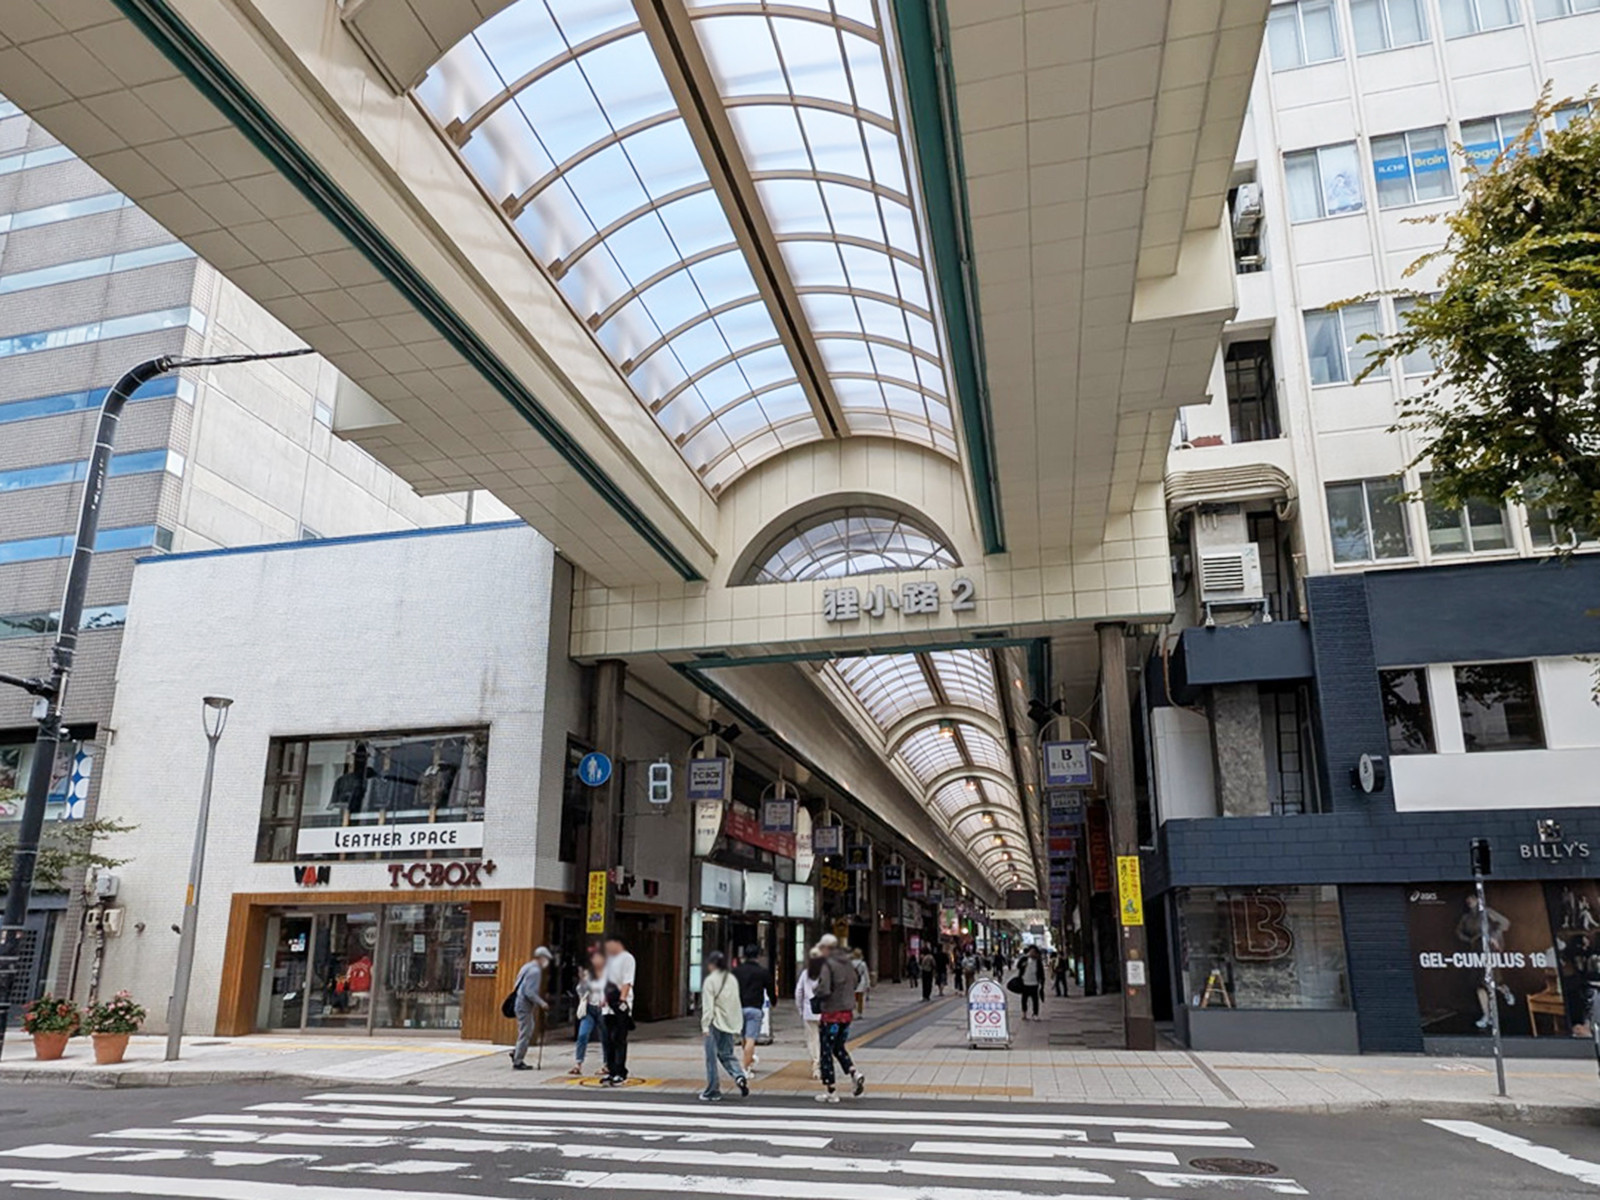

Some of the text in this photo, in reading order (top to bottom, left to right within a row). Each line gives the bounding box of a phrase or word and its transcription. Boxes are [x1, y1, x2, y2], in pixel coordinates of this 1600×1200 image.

[1414, 154, 1447, 168] Brain
[824, 578, 976, 622] 狸小路 2
[1061, 748, 1073, 761] B
[335, 830, 457, 848] LEATHER SPACE
[1520, 841, 1590, 858] BILLY'S
[293, 866, 331, 886] VAN
[1419, 952, 1548, 968] GEL-CUMULUS 16
